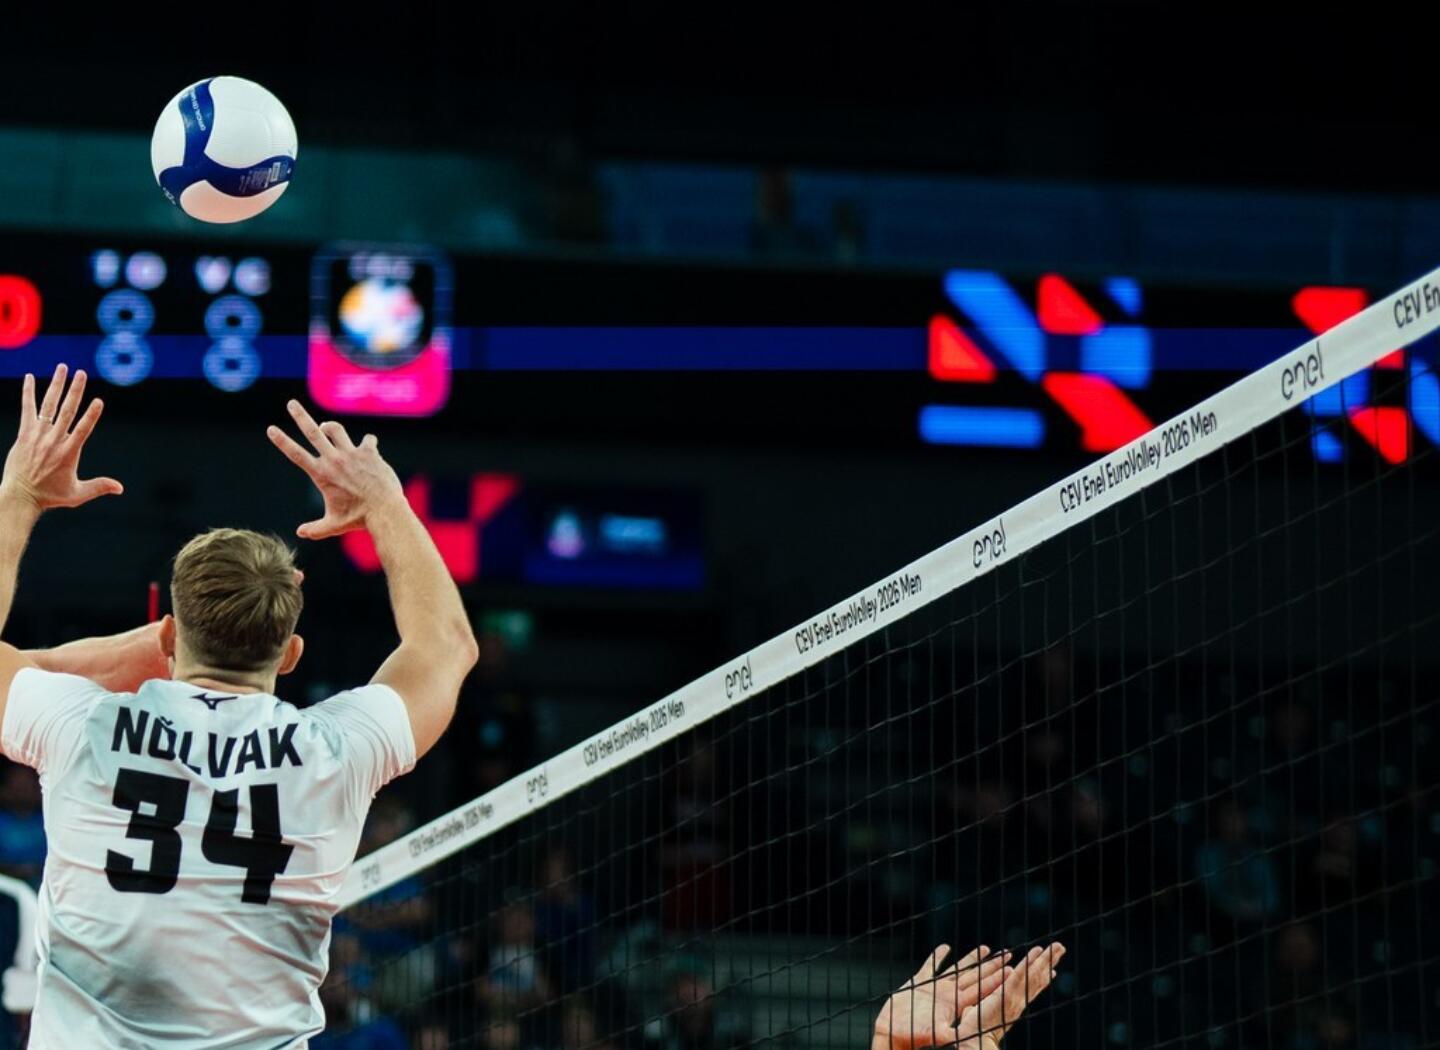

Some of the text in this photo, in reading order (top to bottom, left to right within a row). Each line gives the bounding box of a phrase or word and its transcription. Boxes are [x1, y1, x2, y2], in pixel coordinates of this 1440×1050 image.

[1393, 287, 1421, 329] CEV
[1281, 340, 1324, 400] enel
[1060, 411, 1218, 513] CEV Enel EuroVolley 2026 Men
[972, 518, 1007, 568] enel
[795, 623, 814, 655] CEV
[813, 615, 832, 646] Enel
[877, 580, 900, 613] 2026
[899, 573, 922, 601] Men
[725, 655, 753, 699] enel
[104, 768, 295, 905] 34
